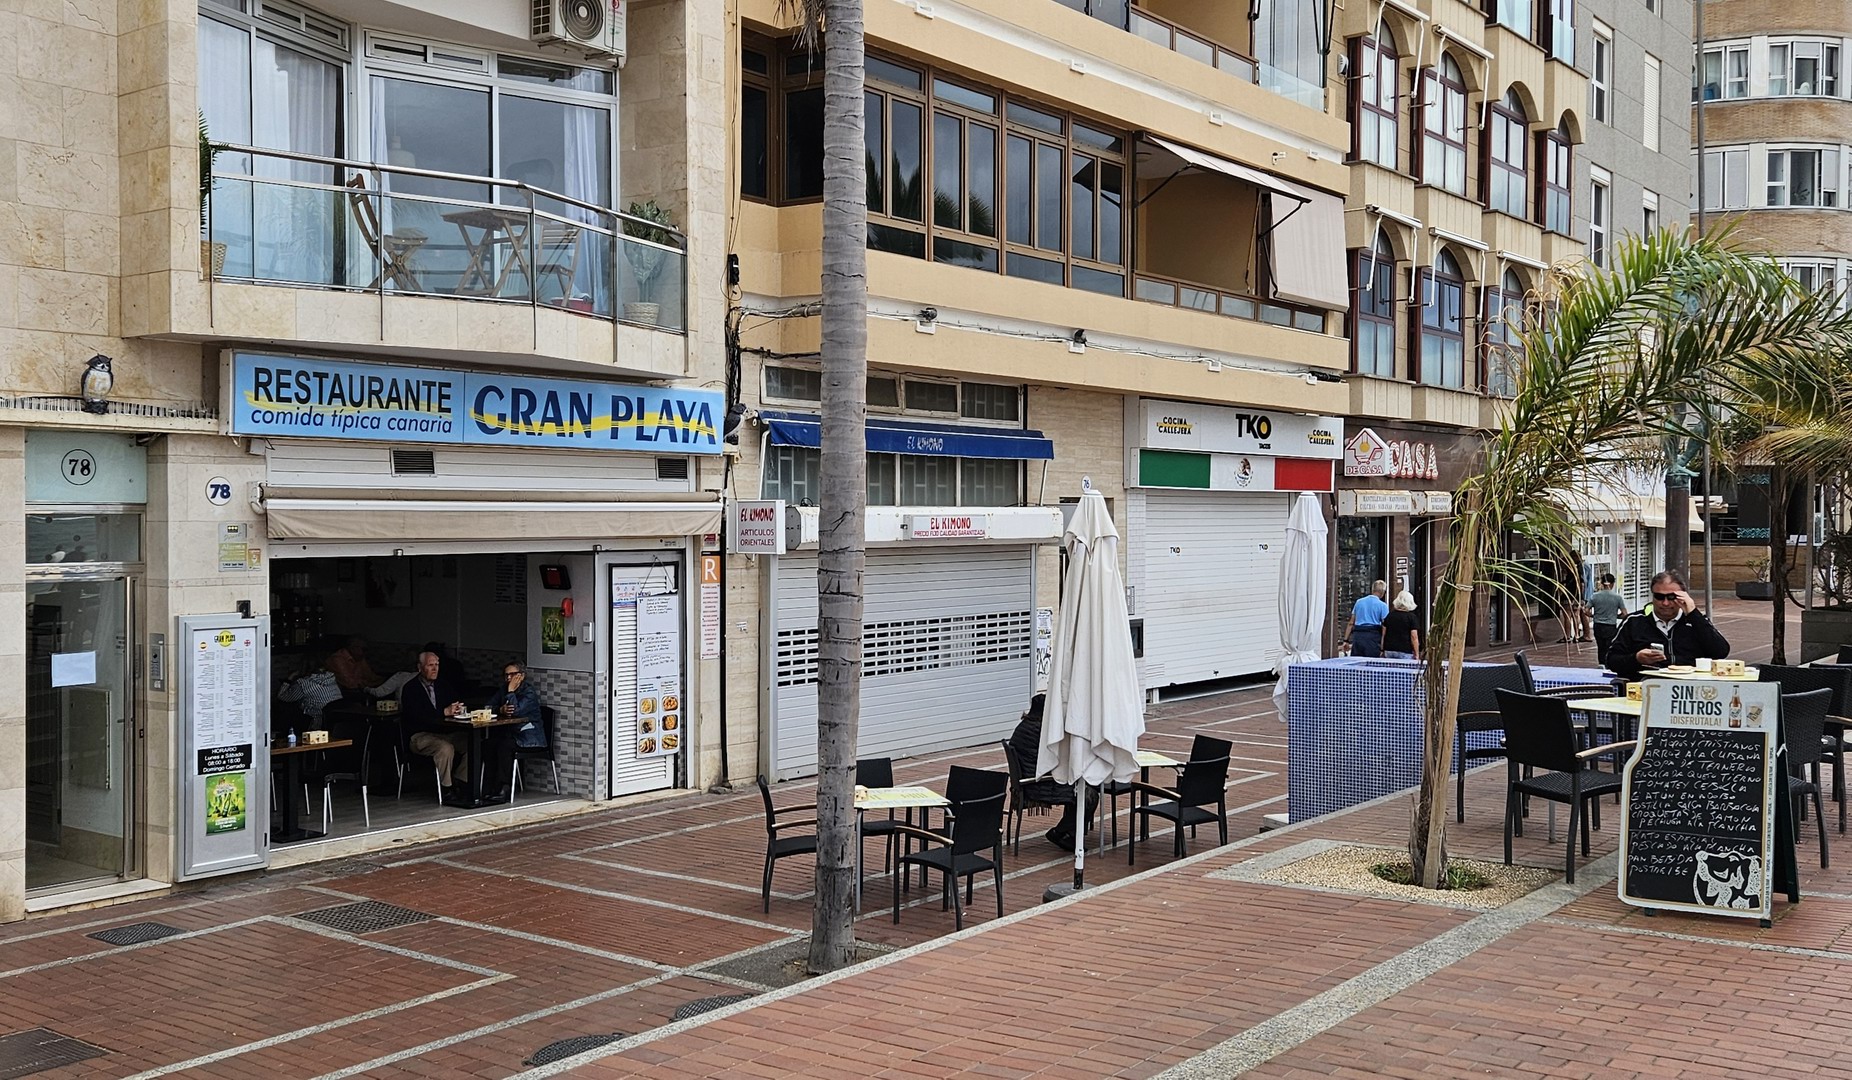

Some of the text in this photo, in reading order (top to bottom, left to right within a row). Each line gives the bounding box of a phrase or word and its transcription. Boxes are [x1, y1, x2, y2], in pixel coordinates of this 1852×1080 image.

[254, 367, 452, 413] RESTAURANTE
[251, 406, 453, 433] comida típica canaria
[473, 385, 716, 445] GRAN PLAYA
[1163, 416, 1188, 426] COCINA
[1158, 425, 1192, 435] CALLEJERA
[1235, 413, 1272, 440] TKO
[1389, 441, 1439, 478] CASA
[68, 459, 91, 476] 78
[1346, 465, 1385, 474] DE CASA
[209, 484, 231, 499] 78
[741, 508, 747, 522] EL
[930, 517, 971, 530] EL KIMONO
[704, 558, 718, 581] R
[1671, 685, 1694, 700] SIN
[1670, 700, 1722, 716] FILTROS
[204, 754, 220, 762] Lunes
[1645, 748, 1681, 758] ARROZ
[1710, 749, 1760, 760] CUBANA
[203, 765, 226, 773] Domingo
[1641, 758, 1675, 769] SOPA
[1680, 759, 1695, 768] DE
[1720, 772, 1761, 783] TIERNO
[1680, 792, 1694, 800] EN
[1631, 809, 1751, 823] CROQUETAS DE JAMON
[1639, 818, 1681, 828] PECHUGA
[1707, 820, 1757, 833] PLANCHA
[1631, 841, 1677, 853] PESCADO
[1705, 841, 1755, 853] PLANCHA
[1627, 854, 1694, 865] PAN BEBIDA
